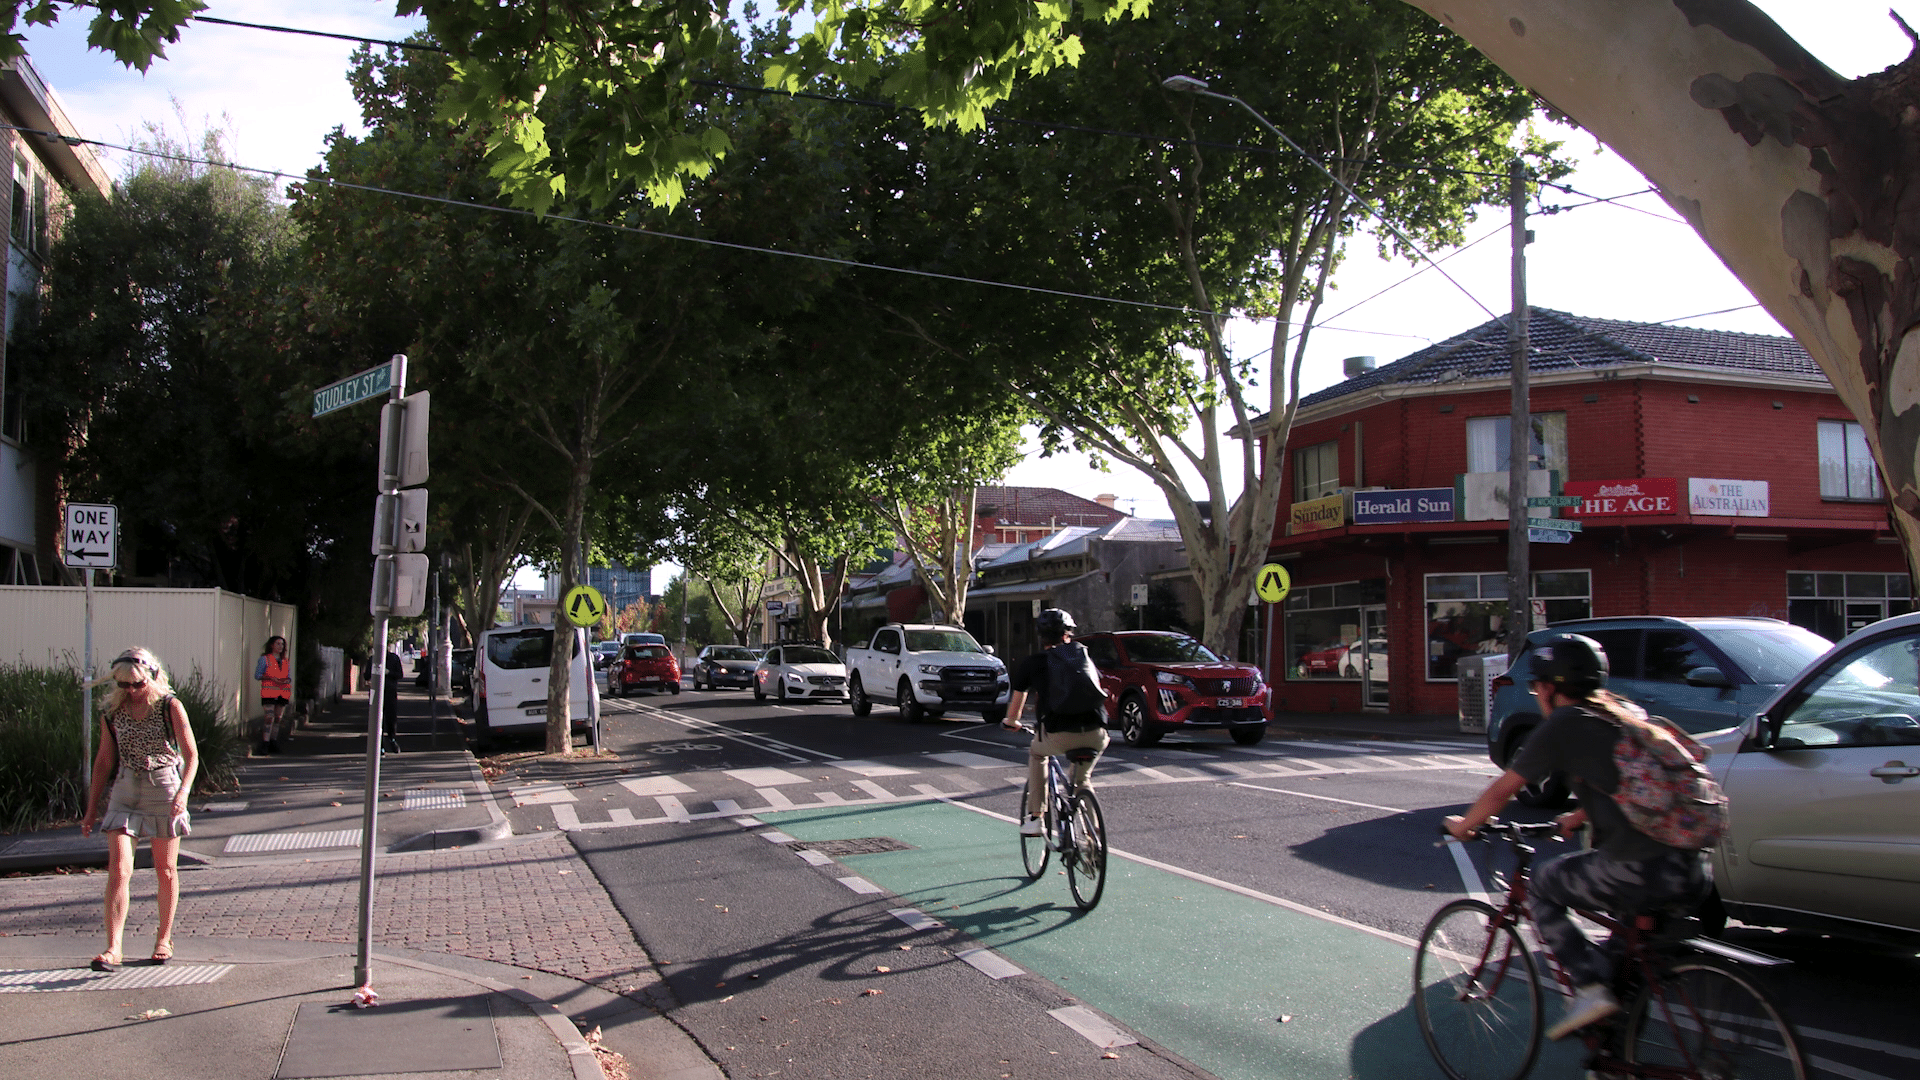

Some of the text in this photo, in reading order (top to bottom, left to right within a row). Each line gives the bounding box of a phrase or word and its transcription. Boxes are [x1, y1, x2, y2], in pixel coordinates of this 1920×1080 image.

[314, 373, 376, 414] STUDLEY ST
[1720, 484, 1743, 497] THE
[1356, 497, 1451, 515] Herald Sun
[1623, 496, 1671, 511] AGE
[1694, 494, 1767, 511] AUSTRALIAN
[74, 510, 109, 525] ONE
[1294, 503, 1342, 524] Sunday
[71, 529, 111, 544] WAY
